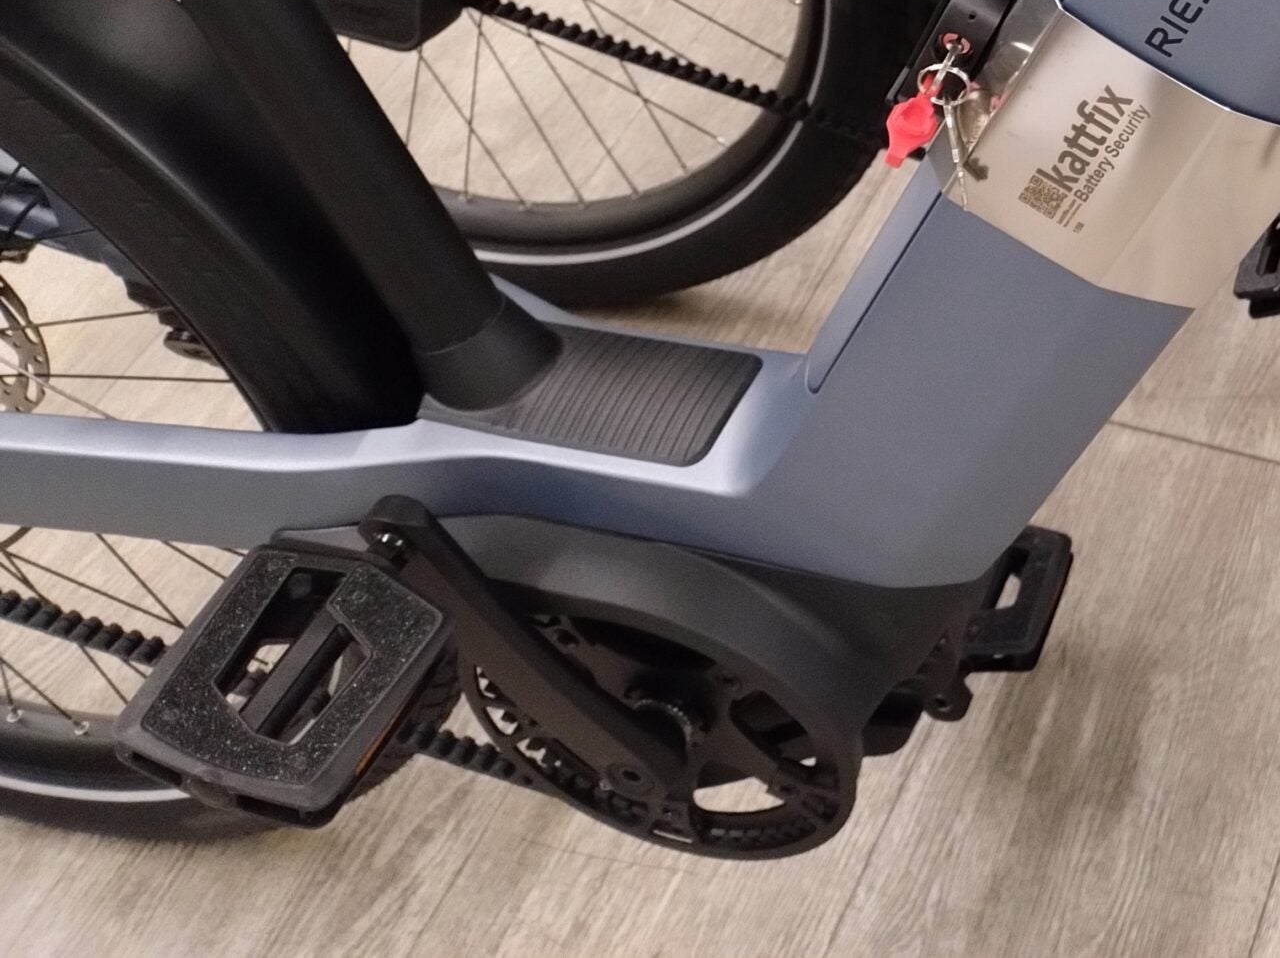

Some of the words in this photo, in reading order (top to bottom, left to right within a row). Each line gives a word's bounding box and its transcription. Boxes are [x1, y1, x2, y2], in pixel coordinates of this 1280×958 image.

[1035, 84, 1134, 193] kattfix
[1073, 157, 1115, 203] Battery
[1104, 104, 1151, 158] Security
